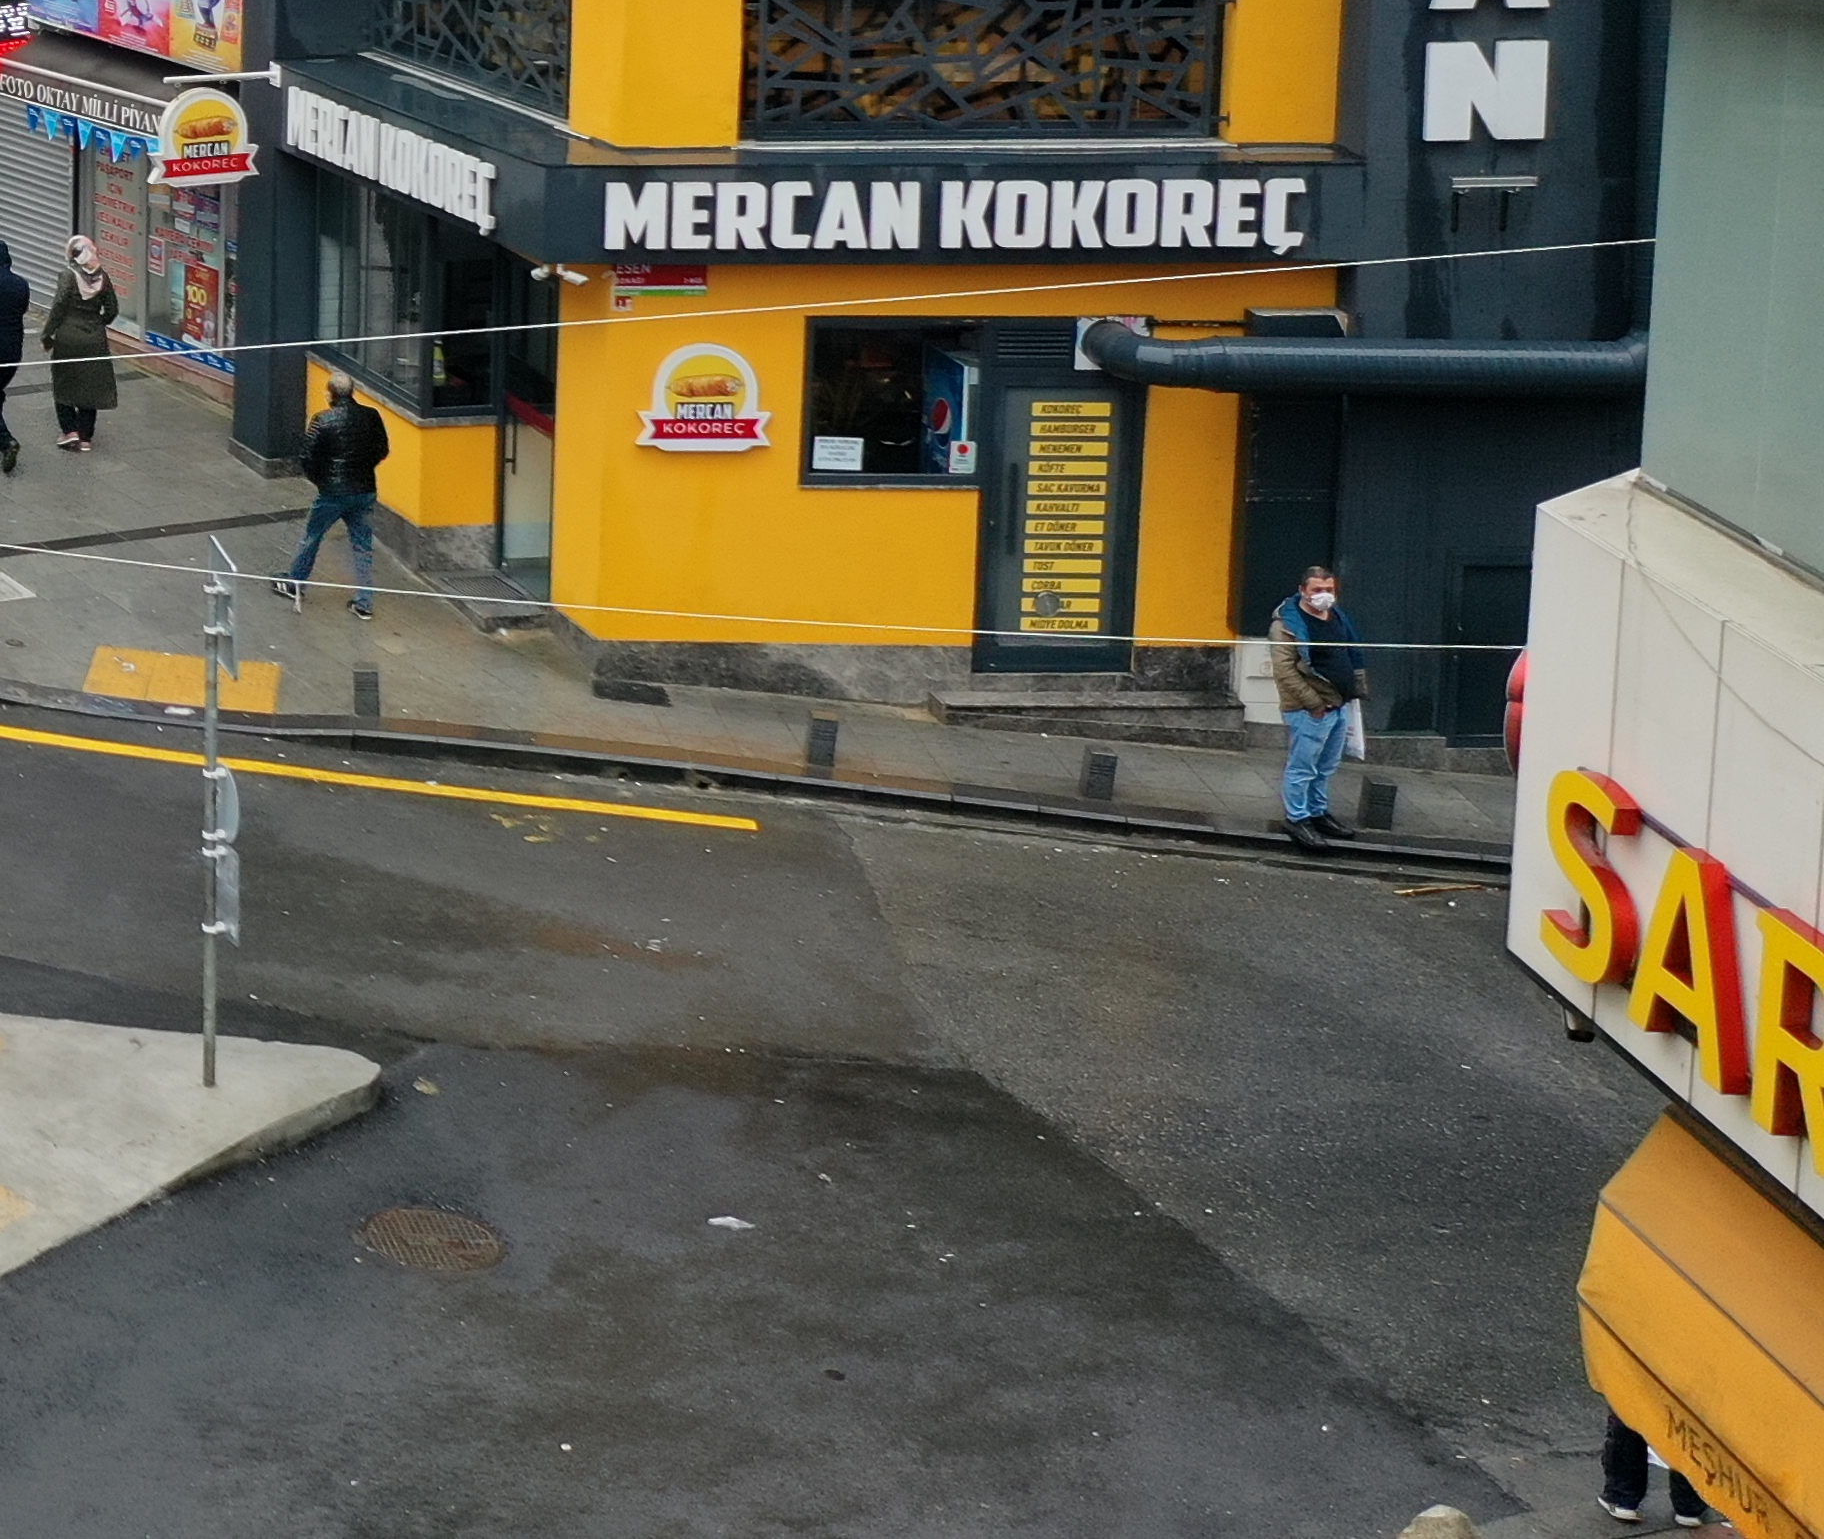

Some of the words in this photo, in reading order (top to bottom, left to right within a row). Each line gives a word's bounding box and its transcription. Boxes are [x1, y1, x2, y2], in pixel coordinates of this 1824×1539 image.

[37, 83, 80, 113] OKTAY
[81, 94, 118, 124] MİLLİ
[121, 103, 161, 134] PİYAN
[183, 143, 229, 159] MERCAN
[287, 86, 380, 180] MERCAN
[379, 123, 497, 236] KOKOREÇ
[604, 180, 920, 252] MERCAN
[939, 177, 1307, 257] KOKOREÇ
[677, 403, 733, 419] MERCAN
[663, 422, 746, 435] KOKOREÇ
[1040, 425, 1095, 434] HAMBURGER
[1038, 444, 1082, 453] MENEMEN
[1038, 462, 1065, 473] KÖFTE
[1036, 484, 1055, 492] SAC
[1057, 484, 1100, 493] KAVURMA
[1034, 523, 1045, 531] ET
[1046, 521, 1077, 532] DÖNER
[1034, 542, 1062, 551] TAVUK
[1063, 540, 1093, 551] DÖNER
[1033, 562, 1054, 570] TOST
[1029, 619, 1056, 629] MİDYE
[1058, 620, 1089, 629] DOLMA
